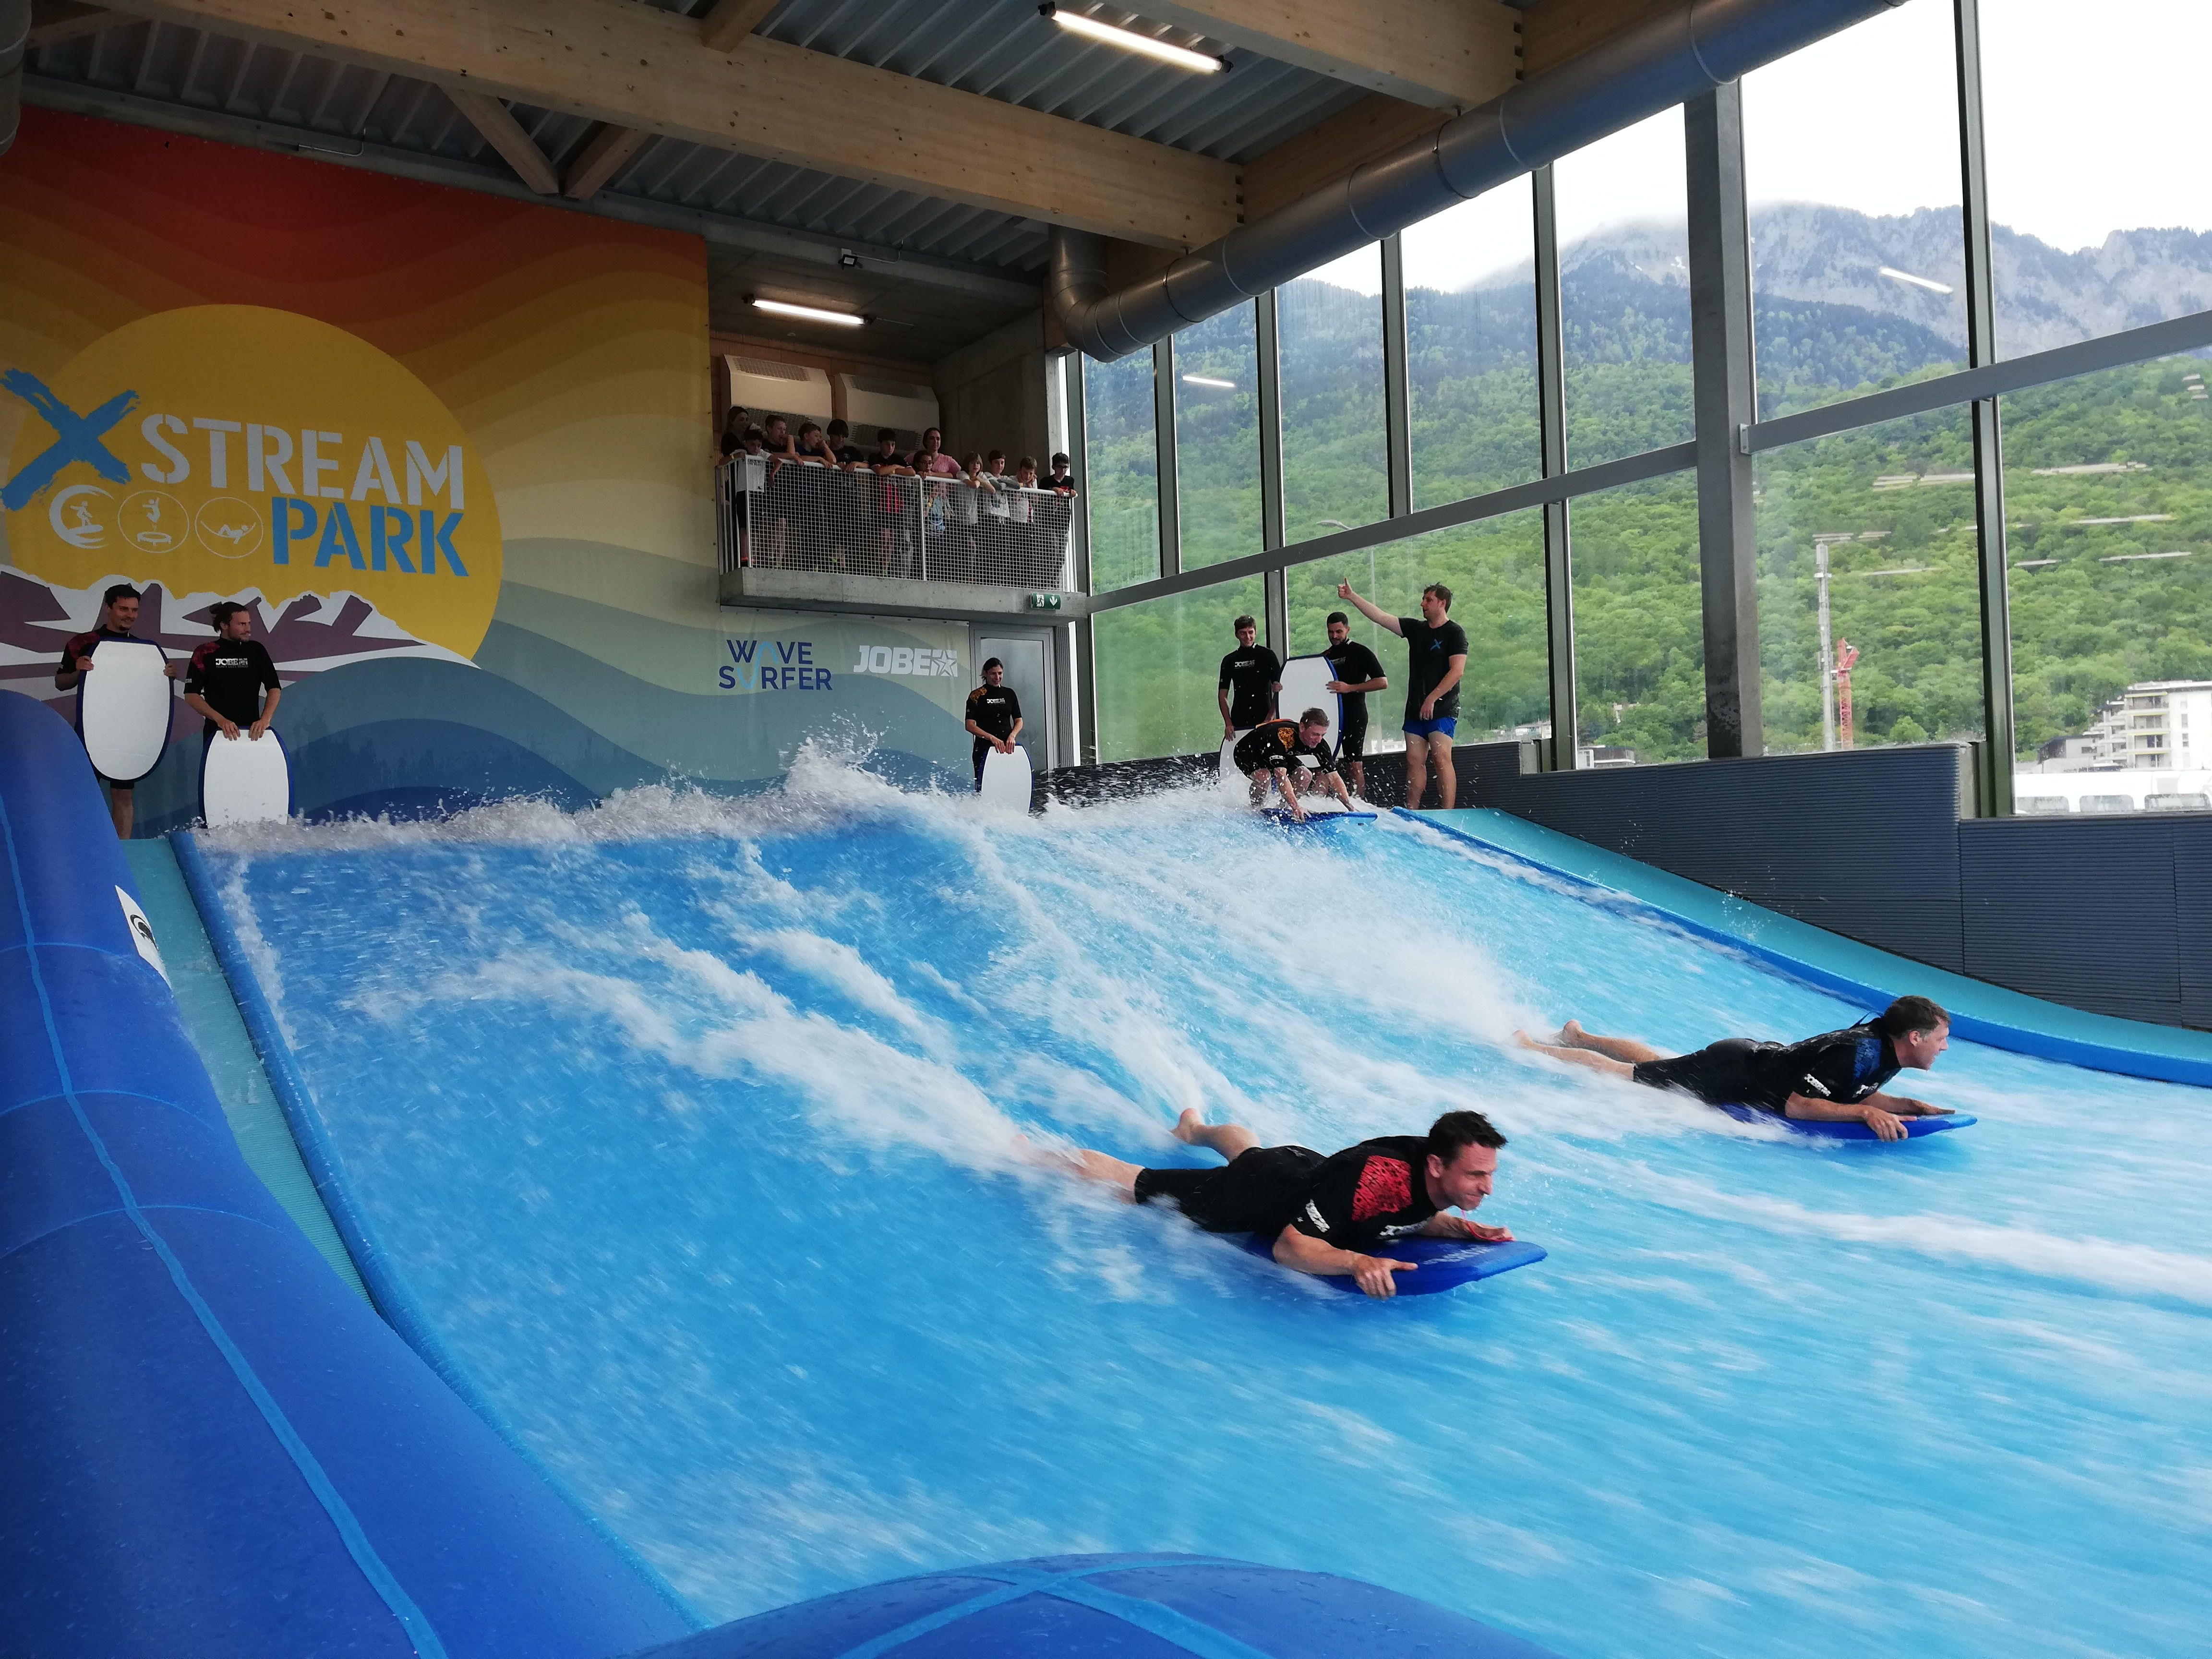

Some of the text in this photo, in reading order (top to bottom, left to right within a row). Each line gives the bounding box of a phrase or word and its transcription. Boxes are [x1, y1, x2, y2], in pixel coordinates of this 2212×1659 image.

[271, 496, 469, 576] PARK
[854, 645, 933, 675] JOBE
[718, 666, 833, 690] SURFER
